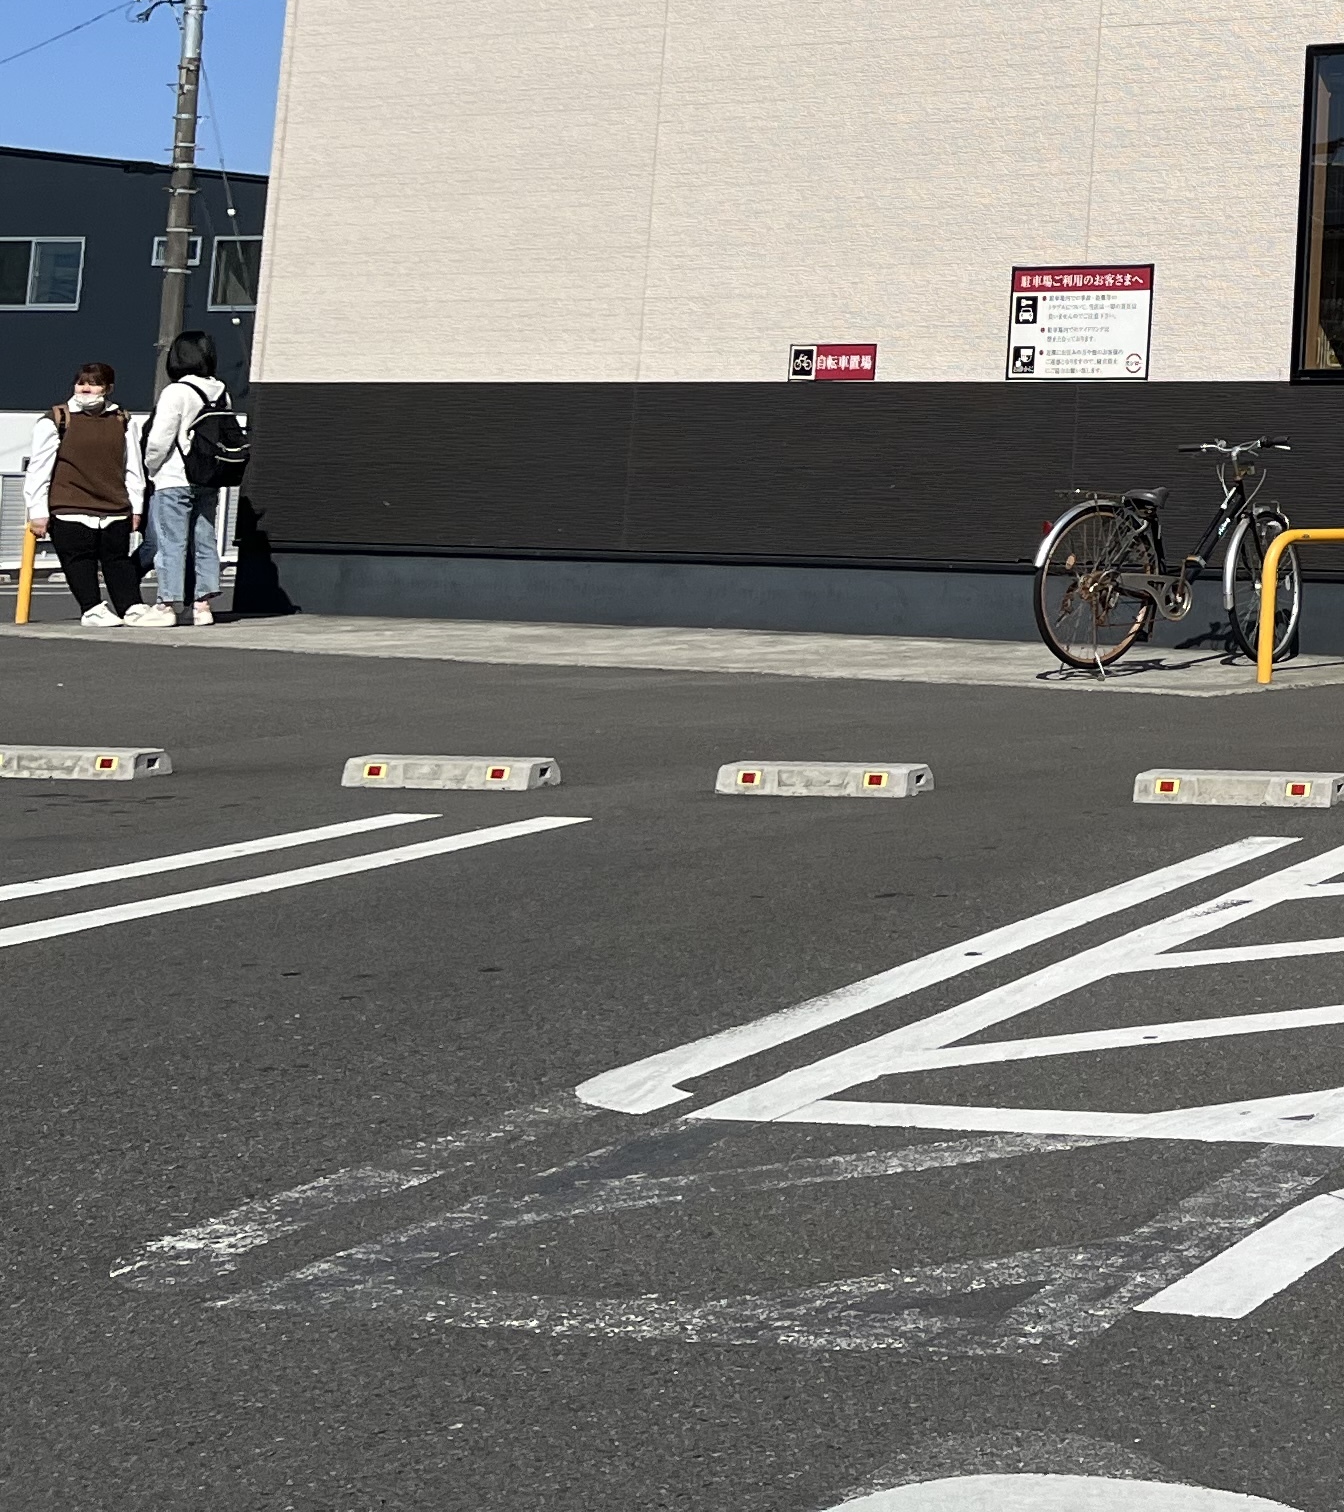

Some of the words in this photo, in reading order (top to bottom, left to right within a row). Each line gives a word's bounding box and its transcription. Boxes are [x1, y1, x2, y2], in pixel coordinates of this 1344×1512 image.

[1020, 273, 1144, 288] 駐車場ご利用のお客さまへ
[816, 354, 872, 371] 自転車置場
